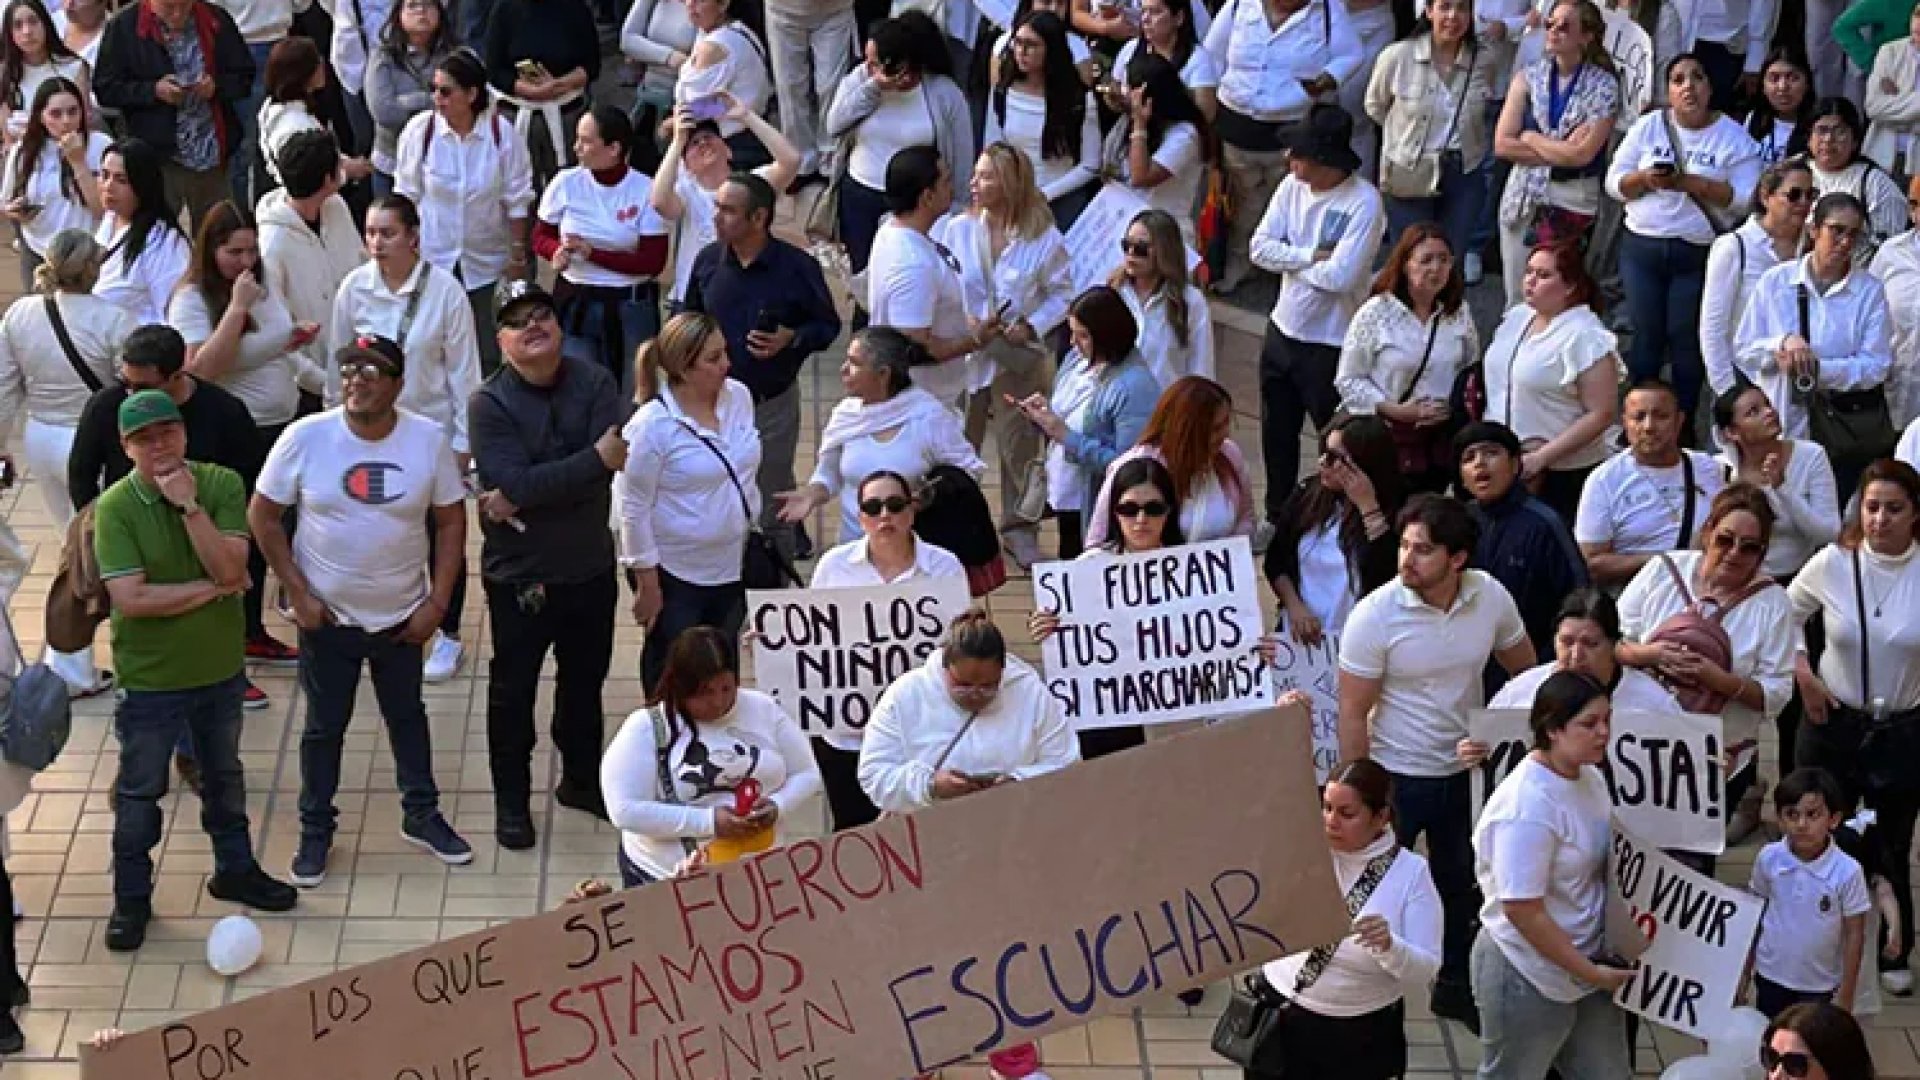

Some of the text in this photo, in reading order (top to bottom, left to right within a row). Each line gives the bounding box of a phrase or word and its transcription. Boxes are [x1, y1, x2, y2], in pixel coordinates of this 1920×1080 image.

[1038, 547, 1235, 614] SI FUERAN
[754, 595, 943, 651] CON LOS
[1051, 622, 1119, 669] TUS
[1136, 605, 1243, 662] HIJOS
[1049, 677, 1081, 718] SI
[1094, 648, 1266, 716] MARCHARIAS?
[1650, 865, 1738, 947] VIVIR
[160, 812, 924, 1080] POR LOS QUE SE FUERON
[888, 868, 1286, 1073] ESCUCHAR
[512, 925, 806, 1078] ESTAMOS
[1620, 957, 1705, 1028] IVIR
